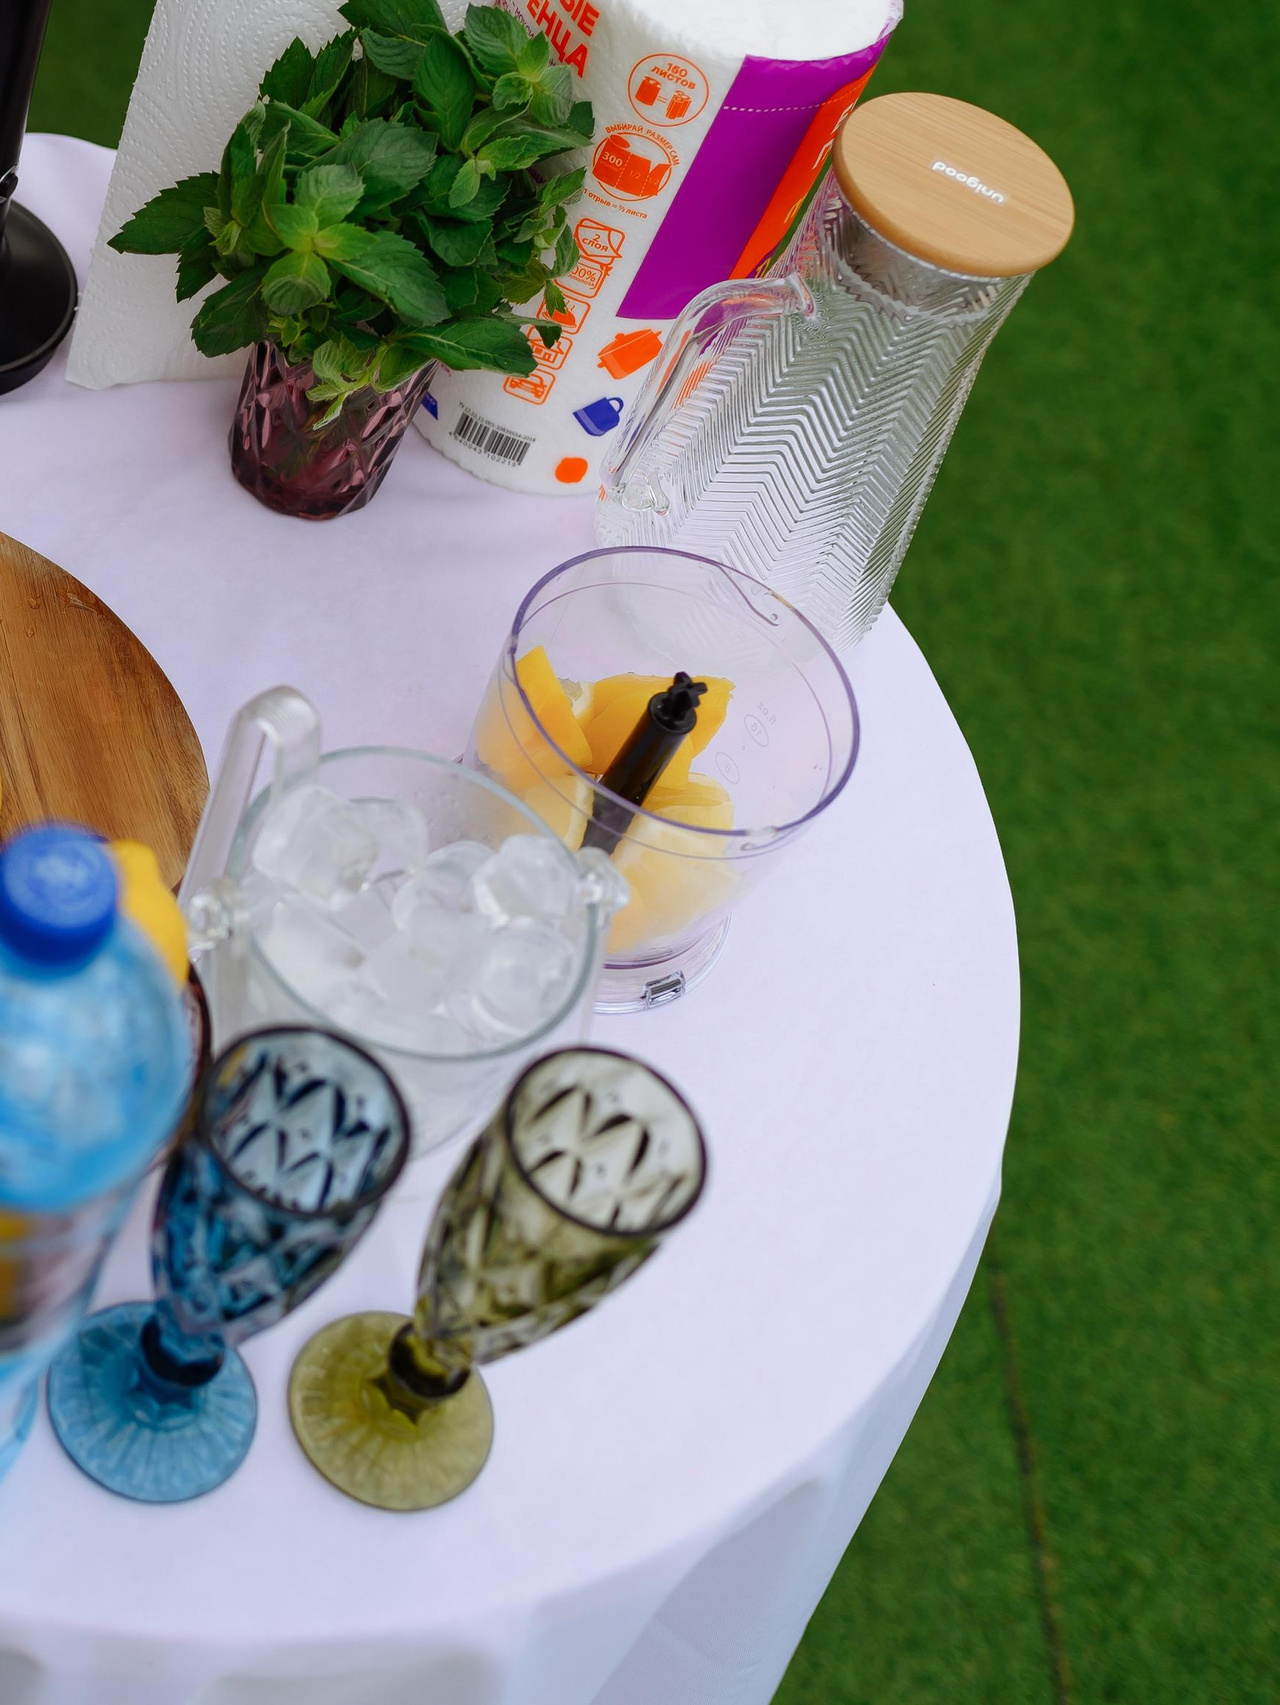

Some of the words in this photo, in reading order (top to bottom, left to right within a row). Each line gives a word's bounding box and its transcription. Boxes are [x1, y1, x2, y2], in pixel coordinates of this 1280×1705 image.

[605, 122, 644, 134] ВЫБИРАЙ
[646, 129, 674, 150] РАЗМЕР
[601, 151, 623, 167] 300
[931, 160, 1006, 204] unigood
[588, 192, 611, 207] отрыв
[625, 208, 648, 219] листа
[593, 233, 601, 242] 2
